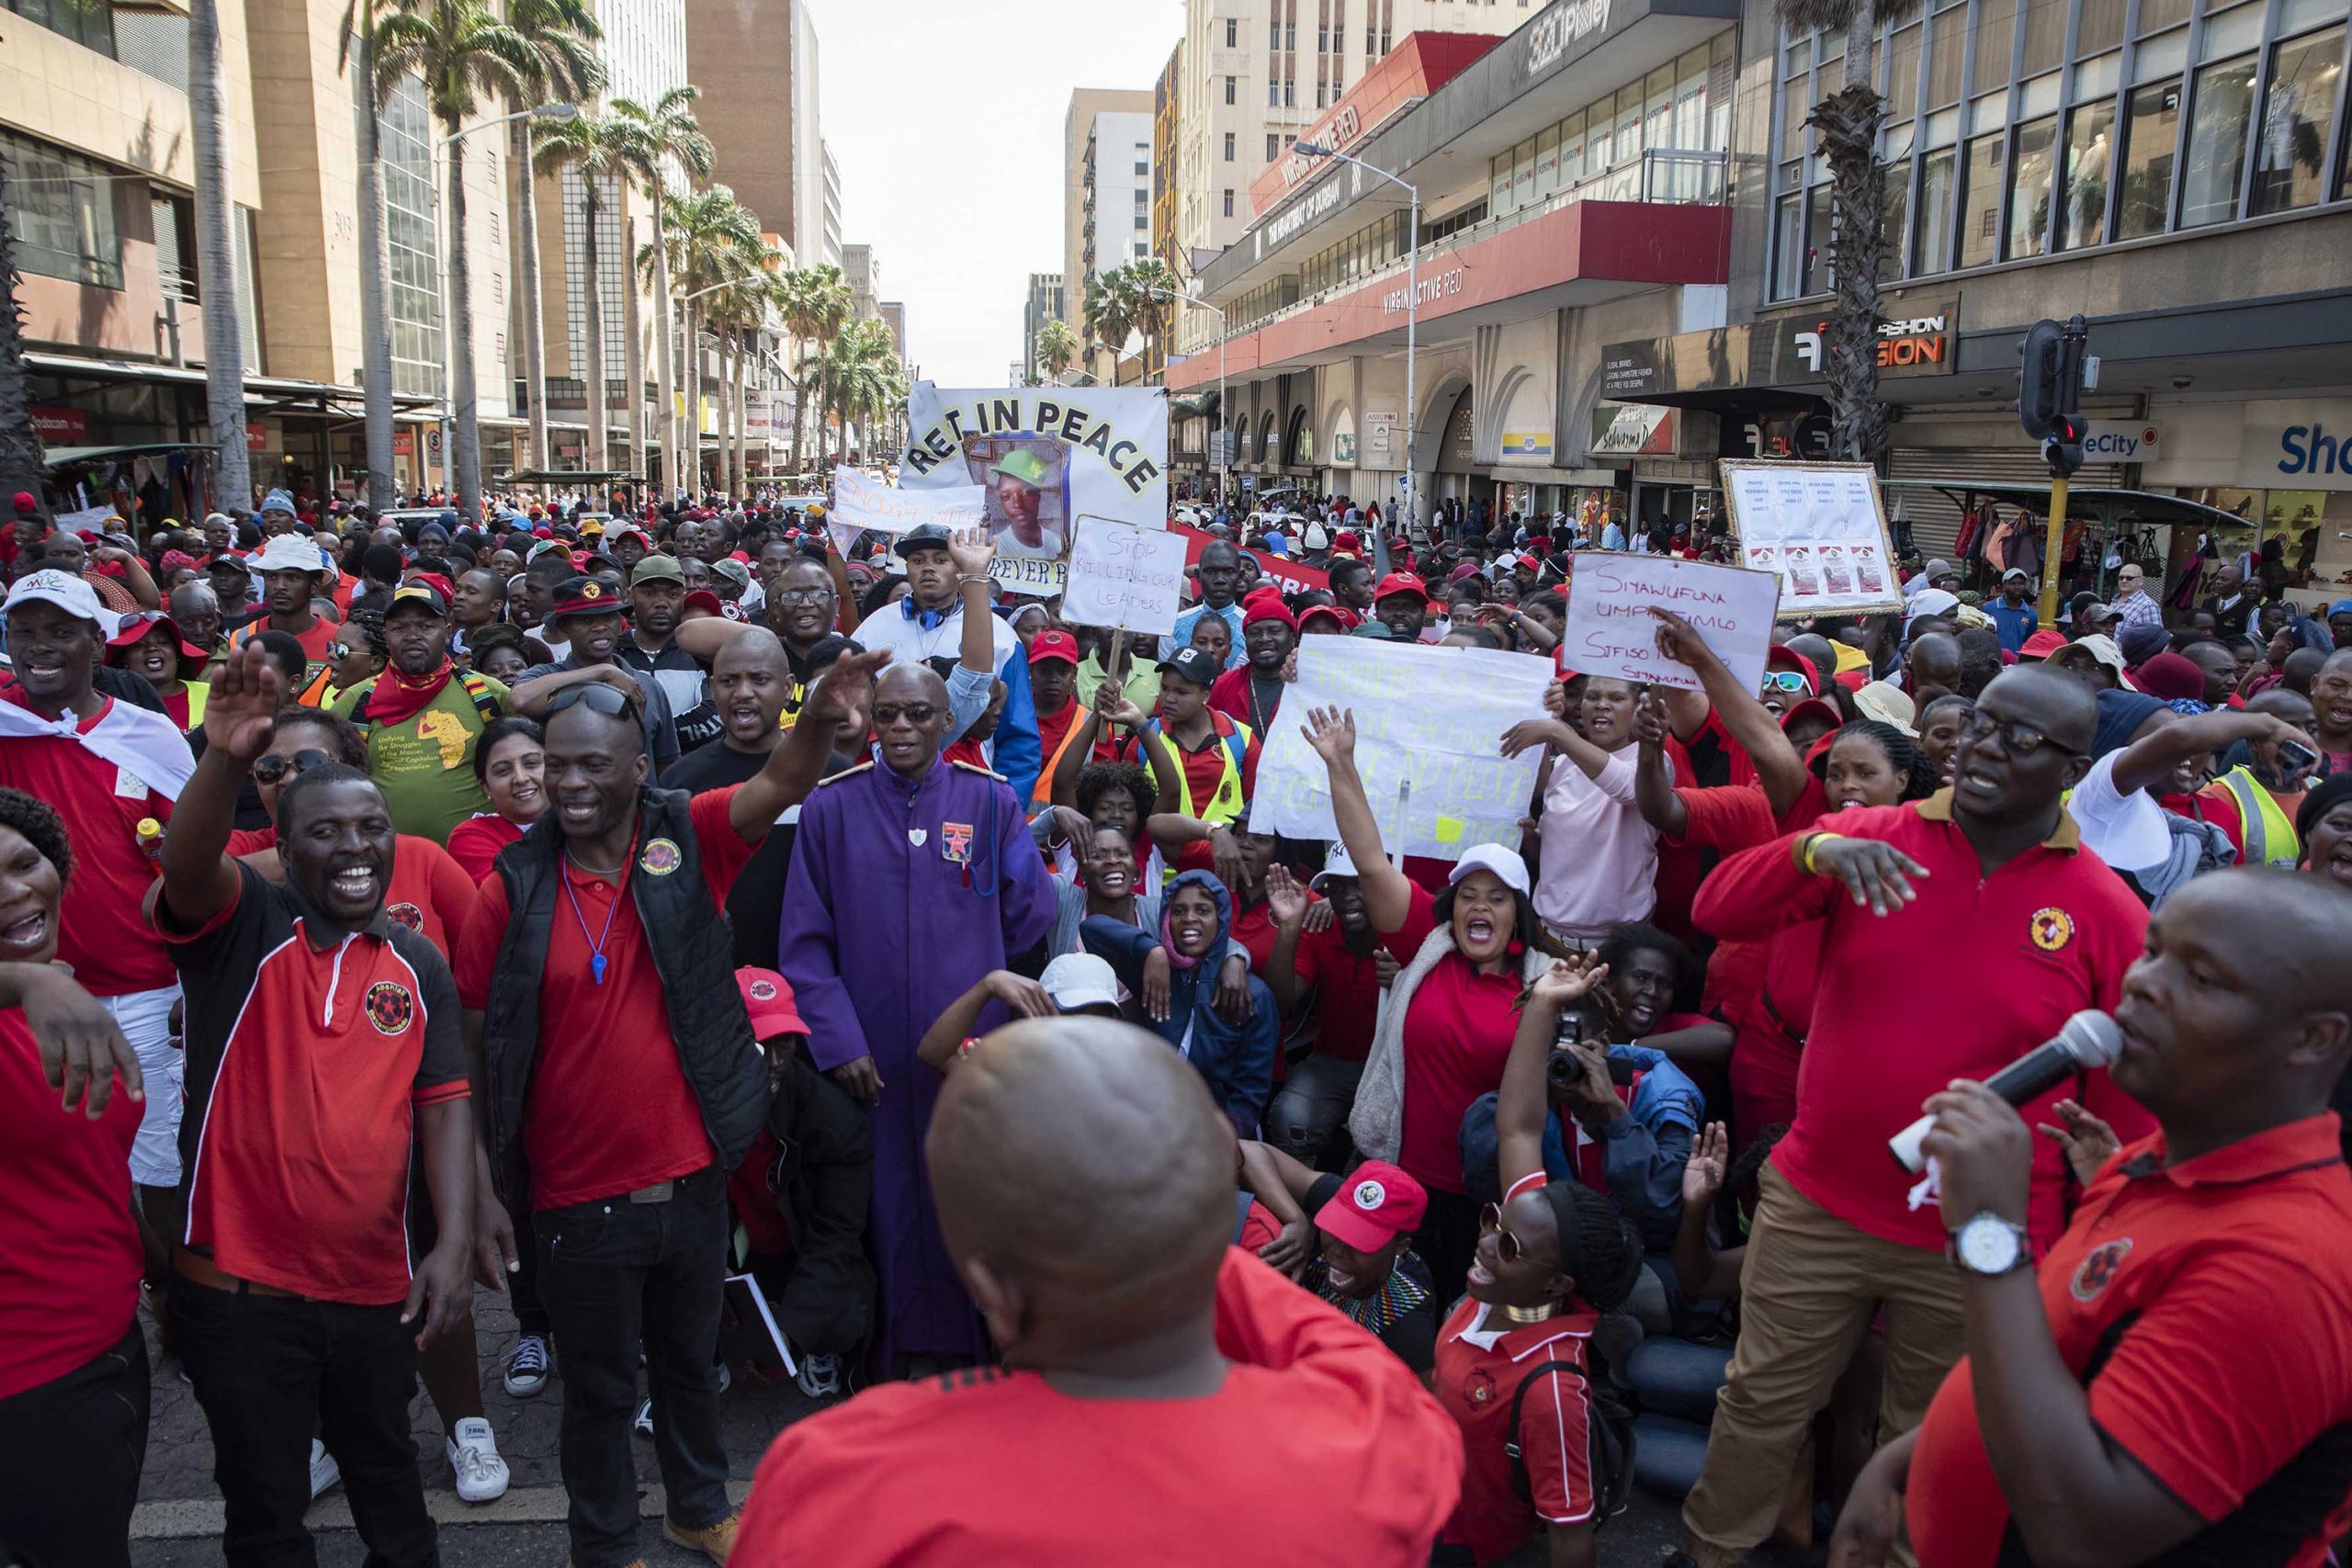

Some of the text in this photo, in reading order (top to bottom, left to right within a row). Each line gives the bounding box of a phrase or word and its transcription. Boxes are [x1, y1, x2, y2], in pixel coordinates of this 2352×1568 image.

[1336, 105, 1362, 142] RED
[1444, 267, 1463, 295] RED
[977, 399, 1020, 434] IN
[1035, 401, 1159, 493] PEACE
[1107, 531, 1159, 559] STOP
[1076, 553, 1175, 591] KILLING OUR
[1097, 588, 1162, 615] LEADERS
[1581, 631, 1650, 660] SIFISO
[378, 735, 405, 743] Unifying
[390, 740, 421, 750] Struggles
[405, 755, 439, 763] Capitalism
